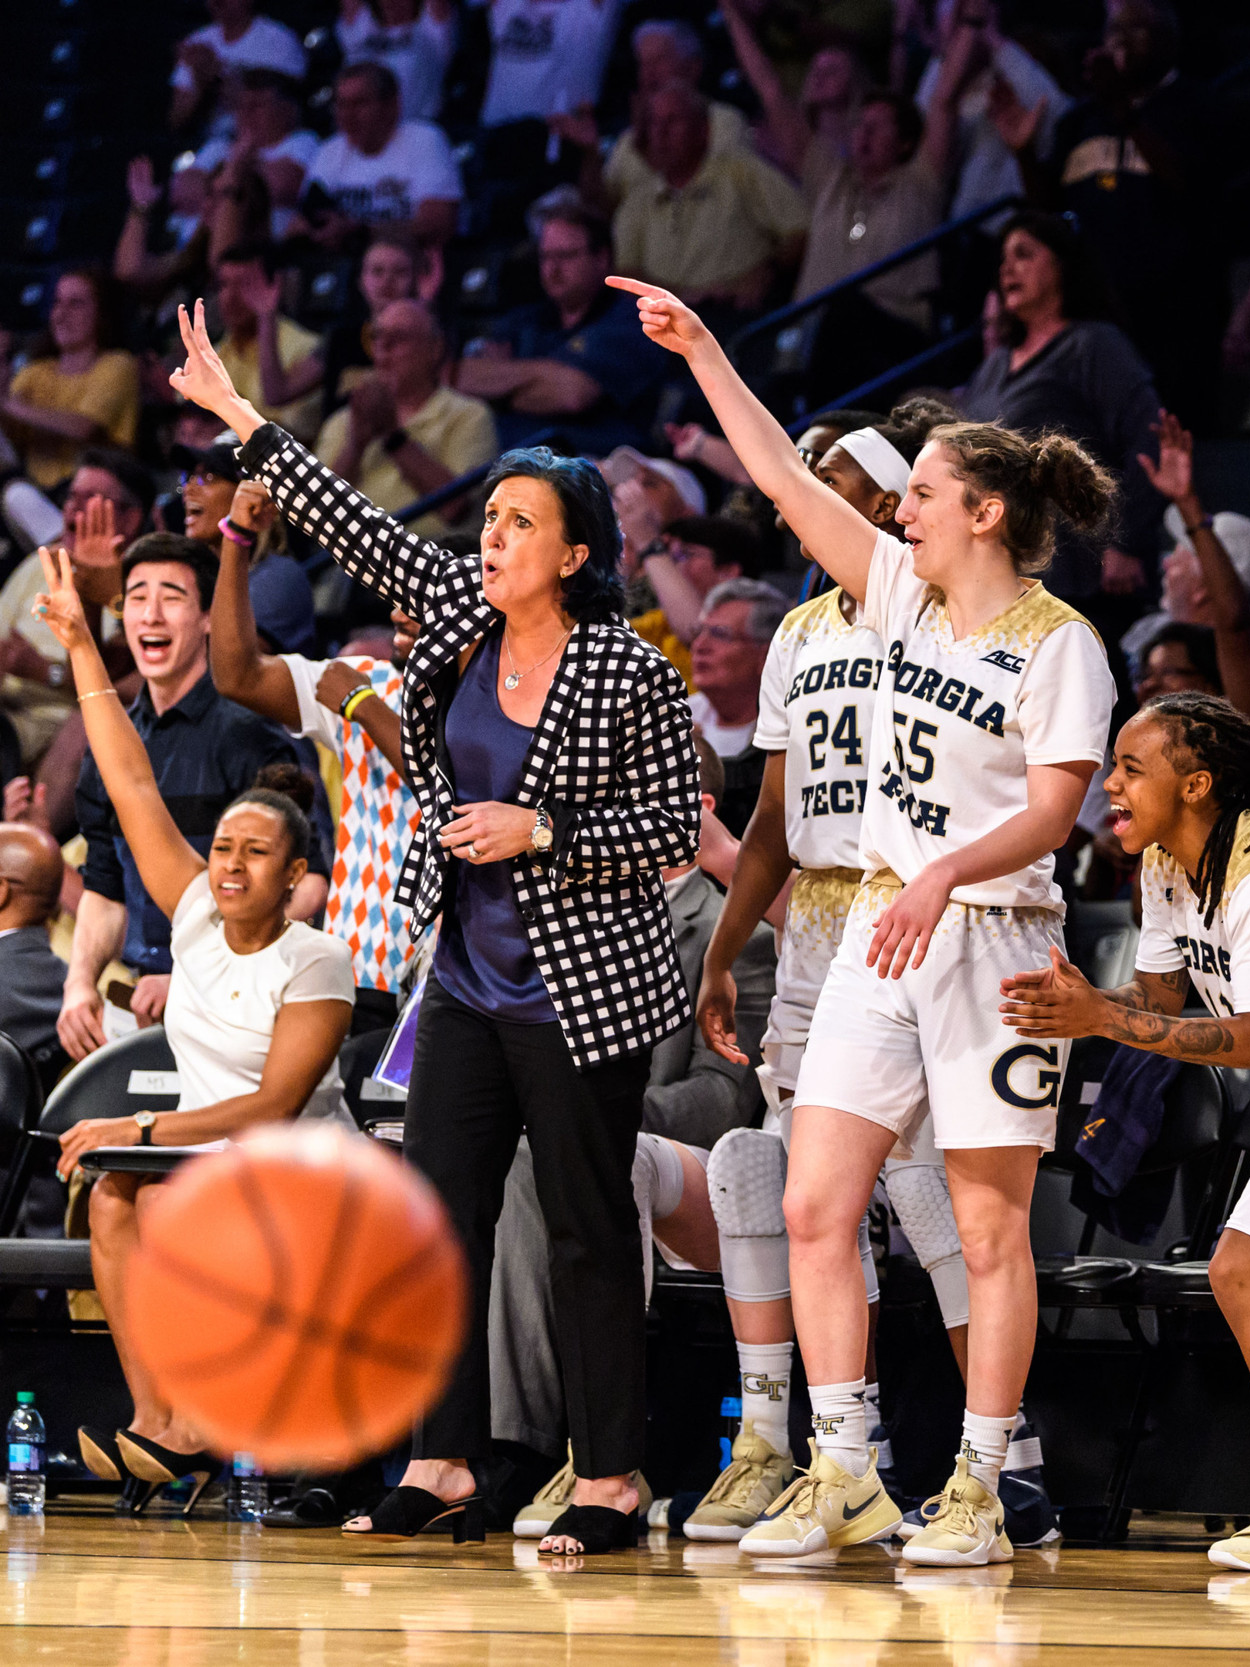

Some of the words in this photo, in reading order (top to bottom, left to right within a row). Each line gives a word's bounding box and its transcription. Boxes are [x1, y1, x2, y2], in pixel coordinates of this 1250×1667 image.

[979, 649, 1027, 675] ACC
[805, 703, 864, 772] 24
[1081, 1117, 1107, 1141] 4
[742, 1371, 788, 1402] GT
